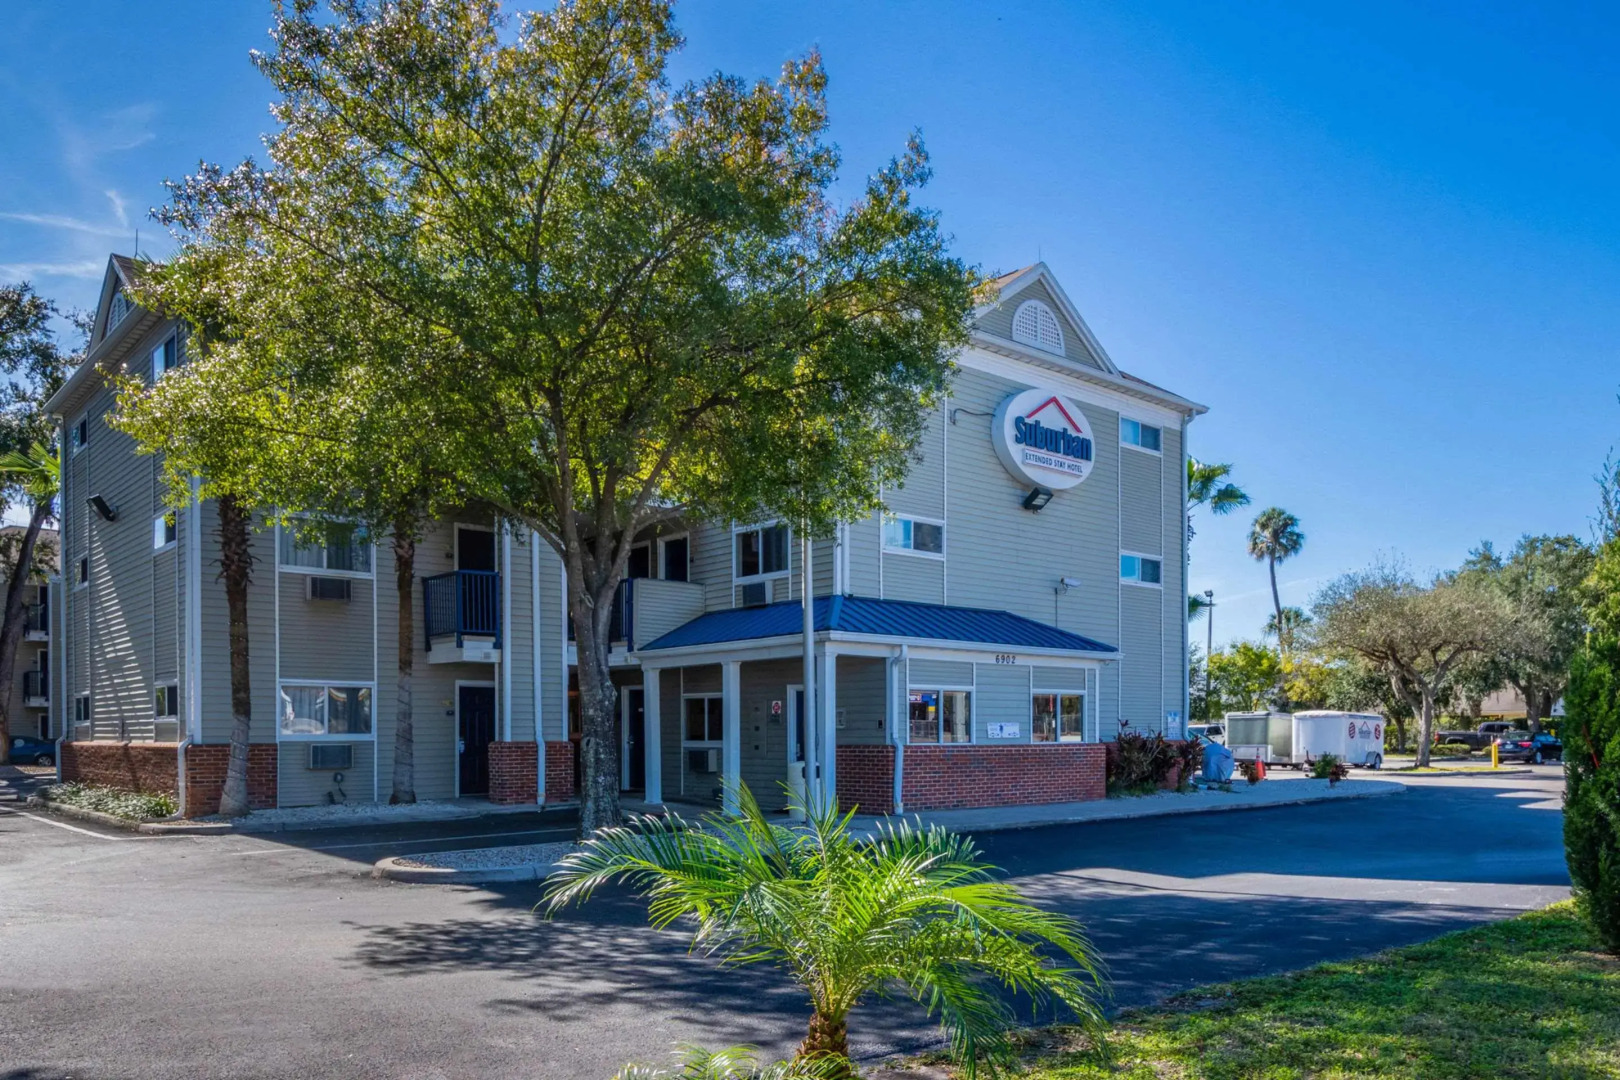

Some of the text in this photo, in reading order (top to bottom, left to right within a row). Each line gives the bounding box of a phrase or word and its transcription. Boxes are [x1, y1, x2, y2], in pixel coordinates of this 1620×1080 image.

[1014, 415, 1091, 461] Suburban
[1025, 452, 1083, 473] EXTENDED STAY HOTEL
[995, 654, 1016, 664] 6902
